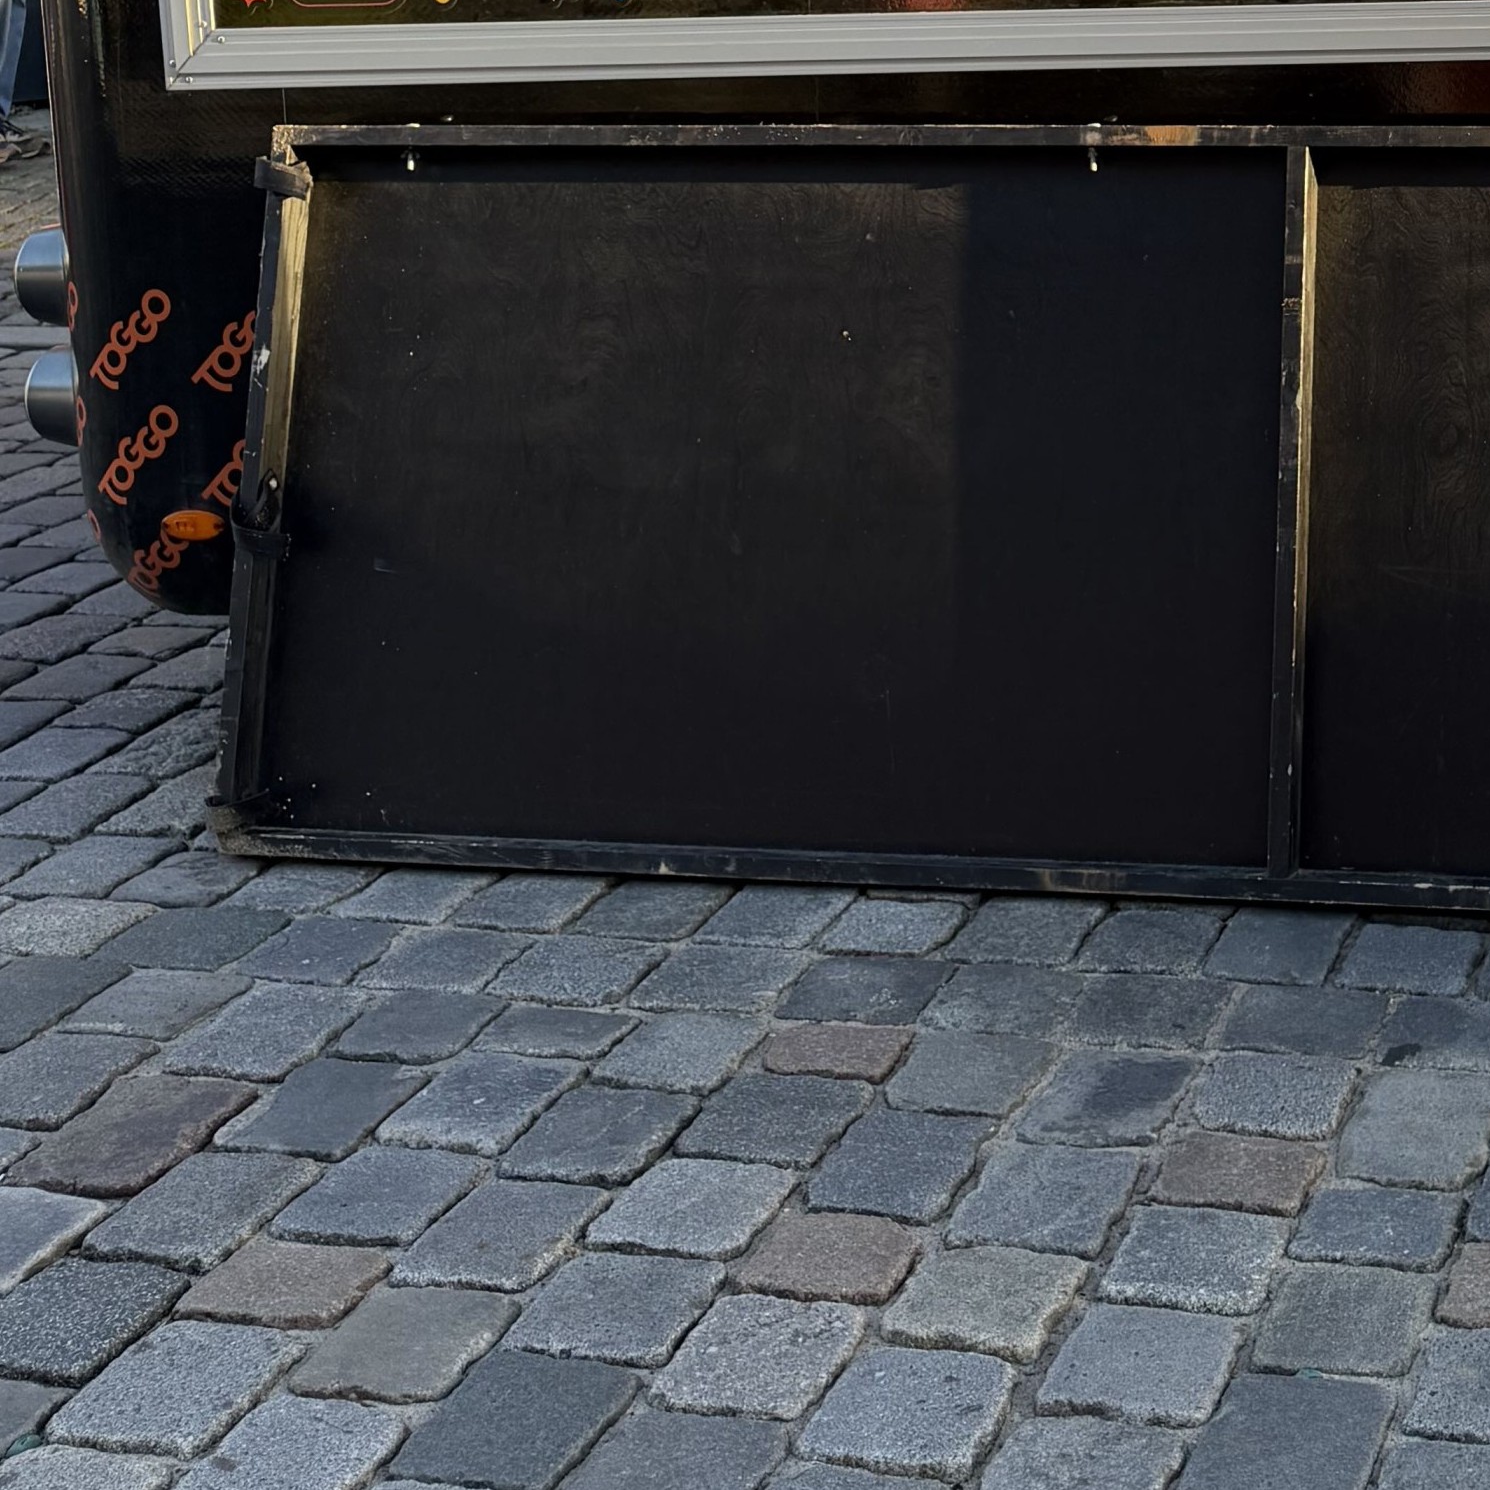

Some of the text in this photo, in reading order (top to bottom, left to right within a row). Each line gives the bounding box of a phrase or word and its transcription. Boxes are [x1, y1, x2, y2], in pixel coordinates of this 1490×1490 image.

[90, 289, 171, 390] TOGGO
[191, 310, 256, 392] TOG
[98, 405, 179, 505] TOGGO
